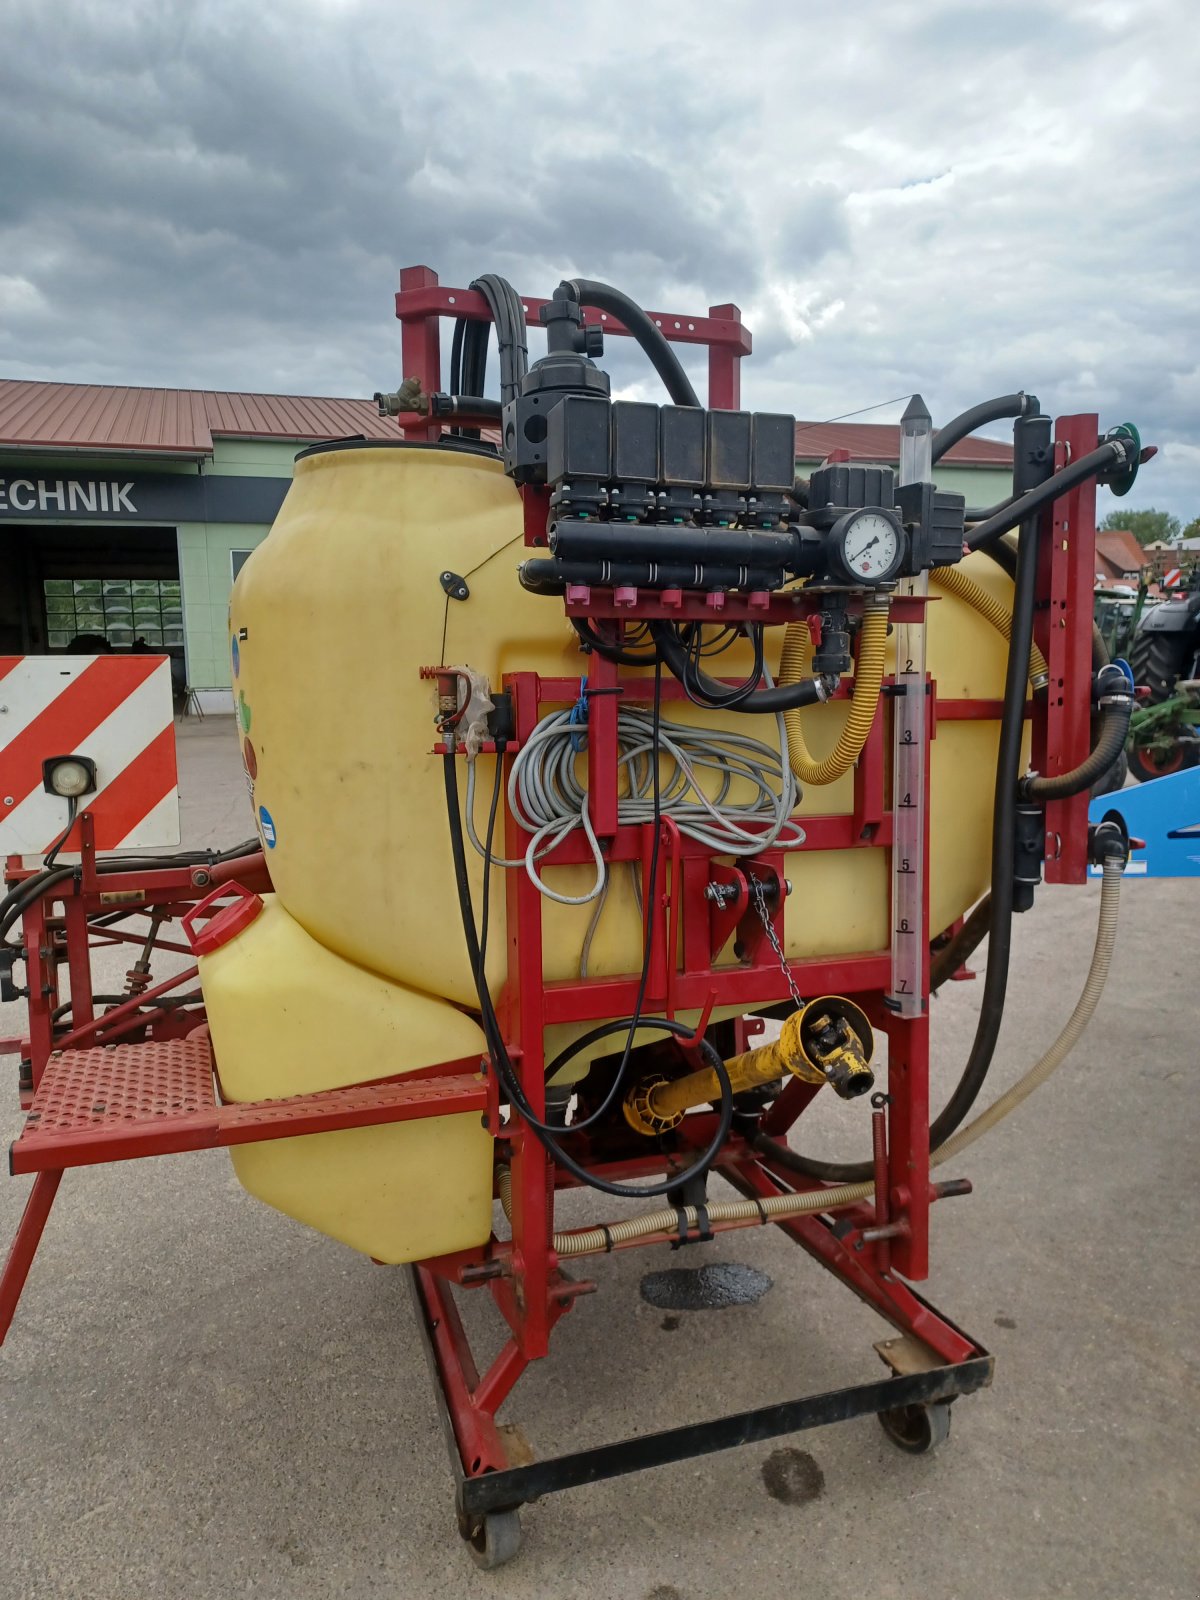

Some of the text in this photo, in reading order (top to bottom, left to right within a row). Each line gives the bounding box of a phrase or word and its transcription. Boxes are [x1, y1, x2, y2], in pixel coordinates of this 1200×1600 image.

[907, 584, 914, 596] 1
[905, 659, 914, 672] 2
[904, 729, 912, 742] 3
[902, 792, 911, 805] 4
[901, 858, 910, 871] 5
[900, 918, 909, 931] 6
[899, 979, 907, 992] 7
